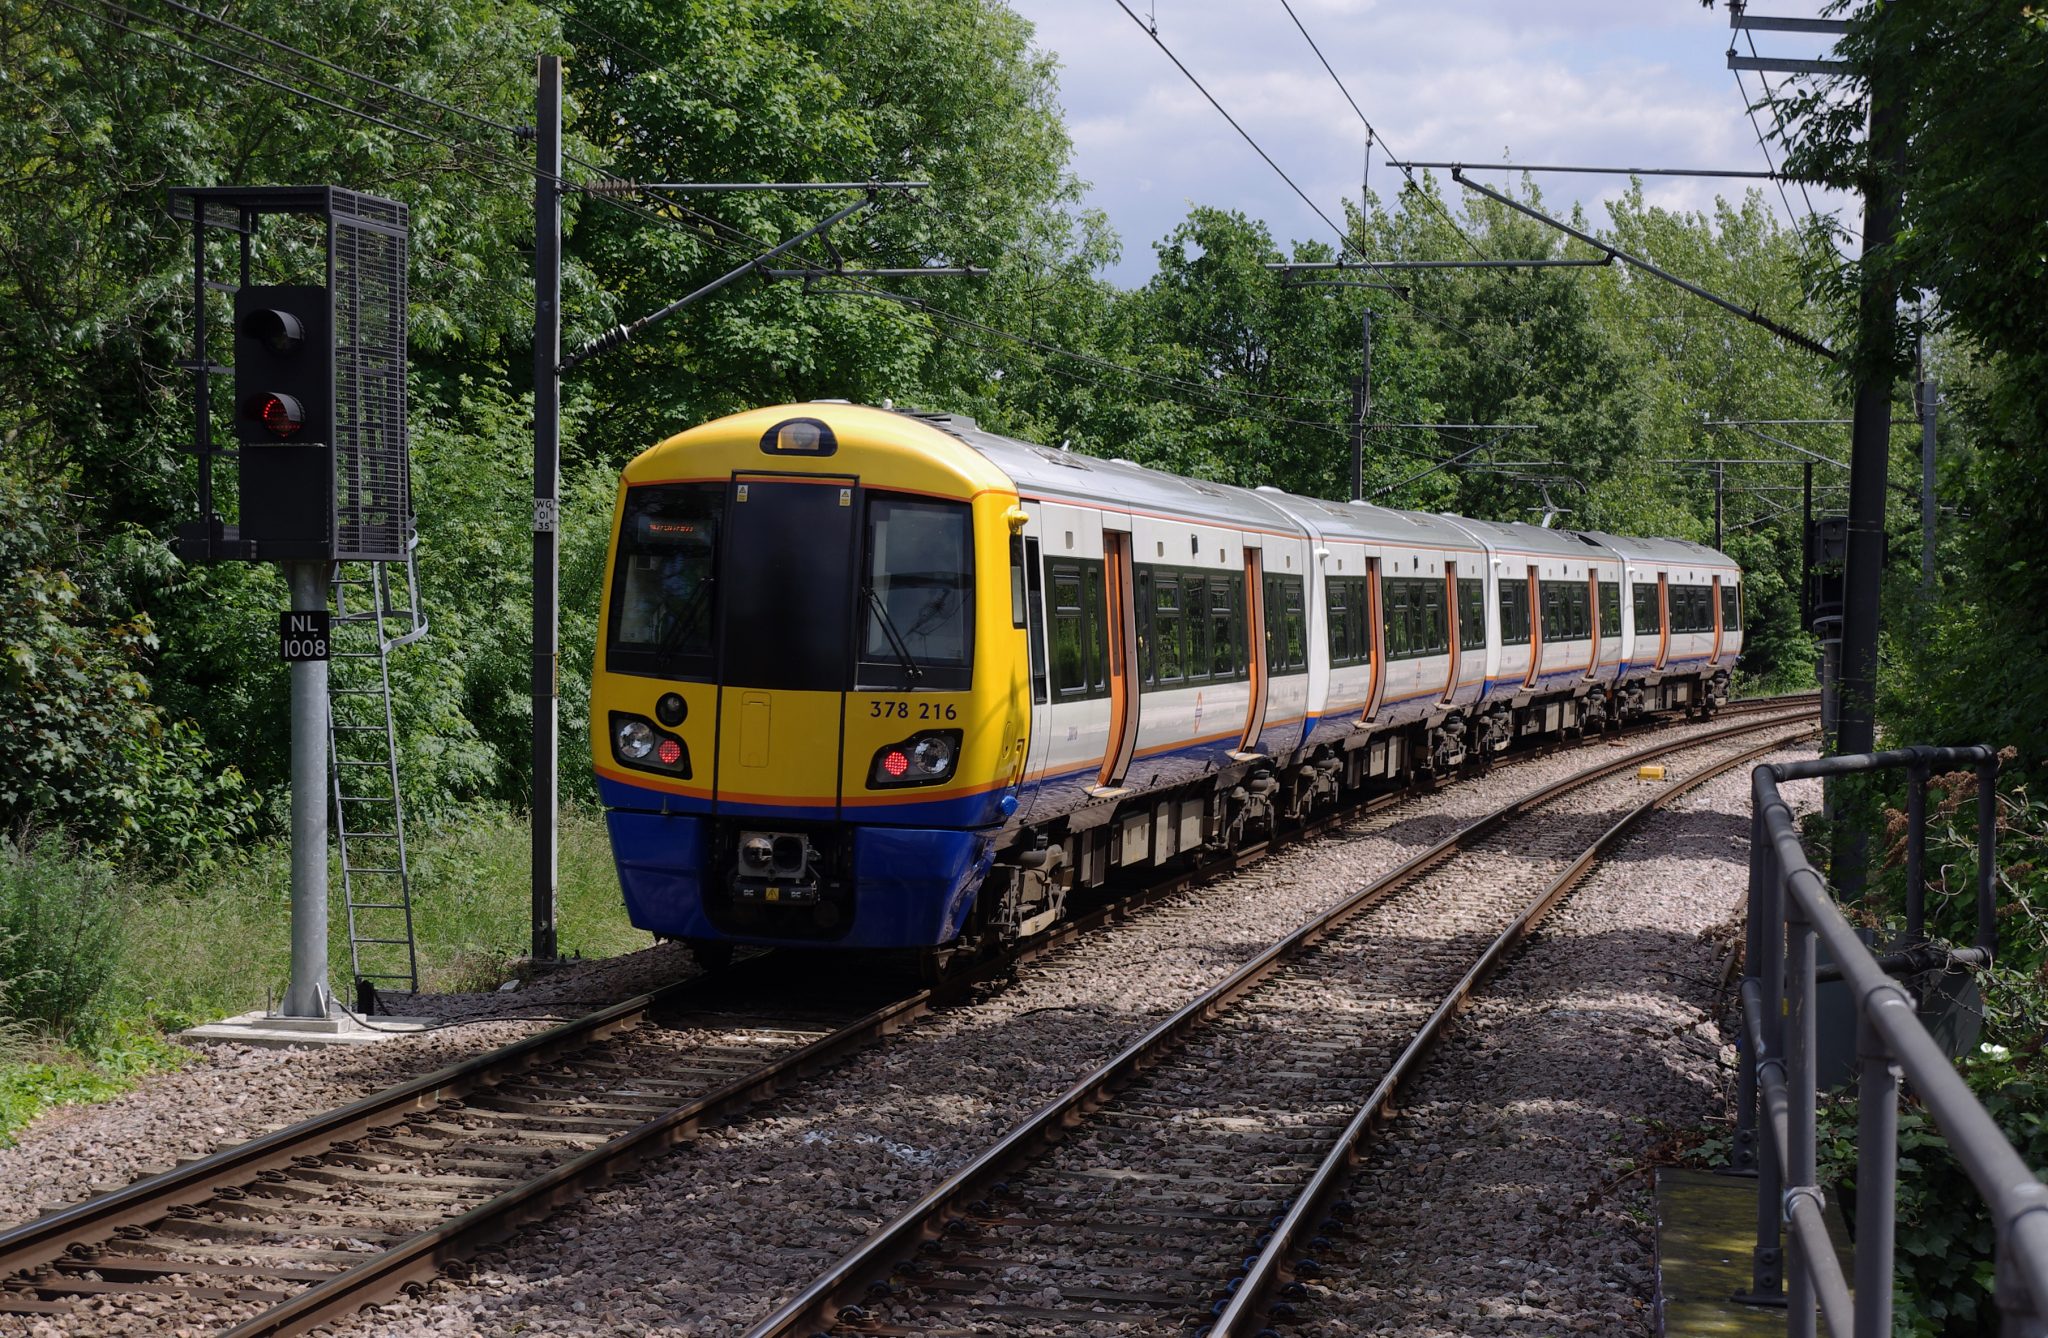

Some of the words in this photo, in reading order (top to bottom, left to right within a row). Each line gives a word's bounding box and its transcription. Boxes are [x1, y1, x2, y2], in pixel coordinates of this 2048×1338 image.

[536, 500, 552, 508] WG
[538, 522, 550, 530] 35
[291, 615, 319, 632] NL
[284, 639, 327, 658] 1008
[870, 701, 909, 719] 378
[918, 702, 957, 721] 216
